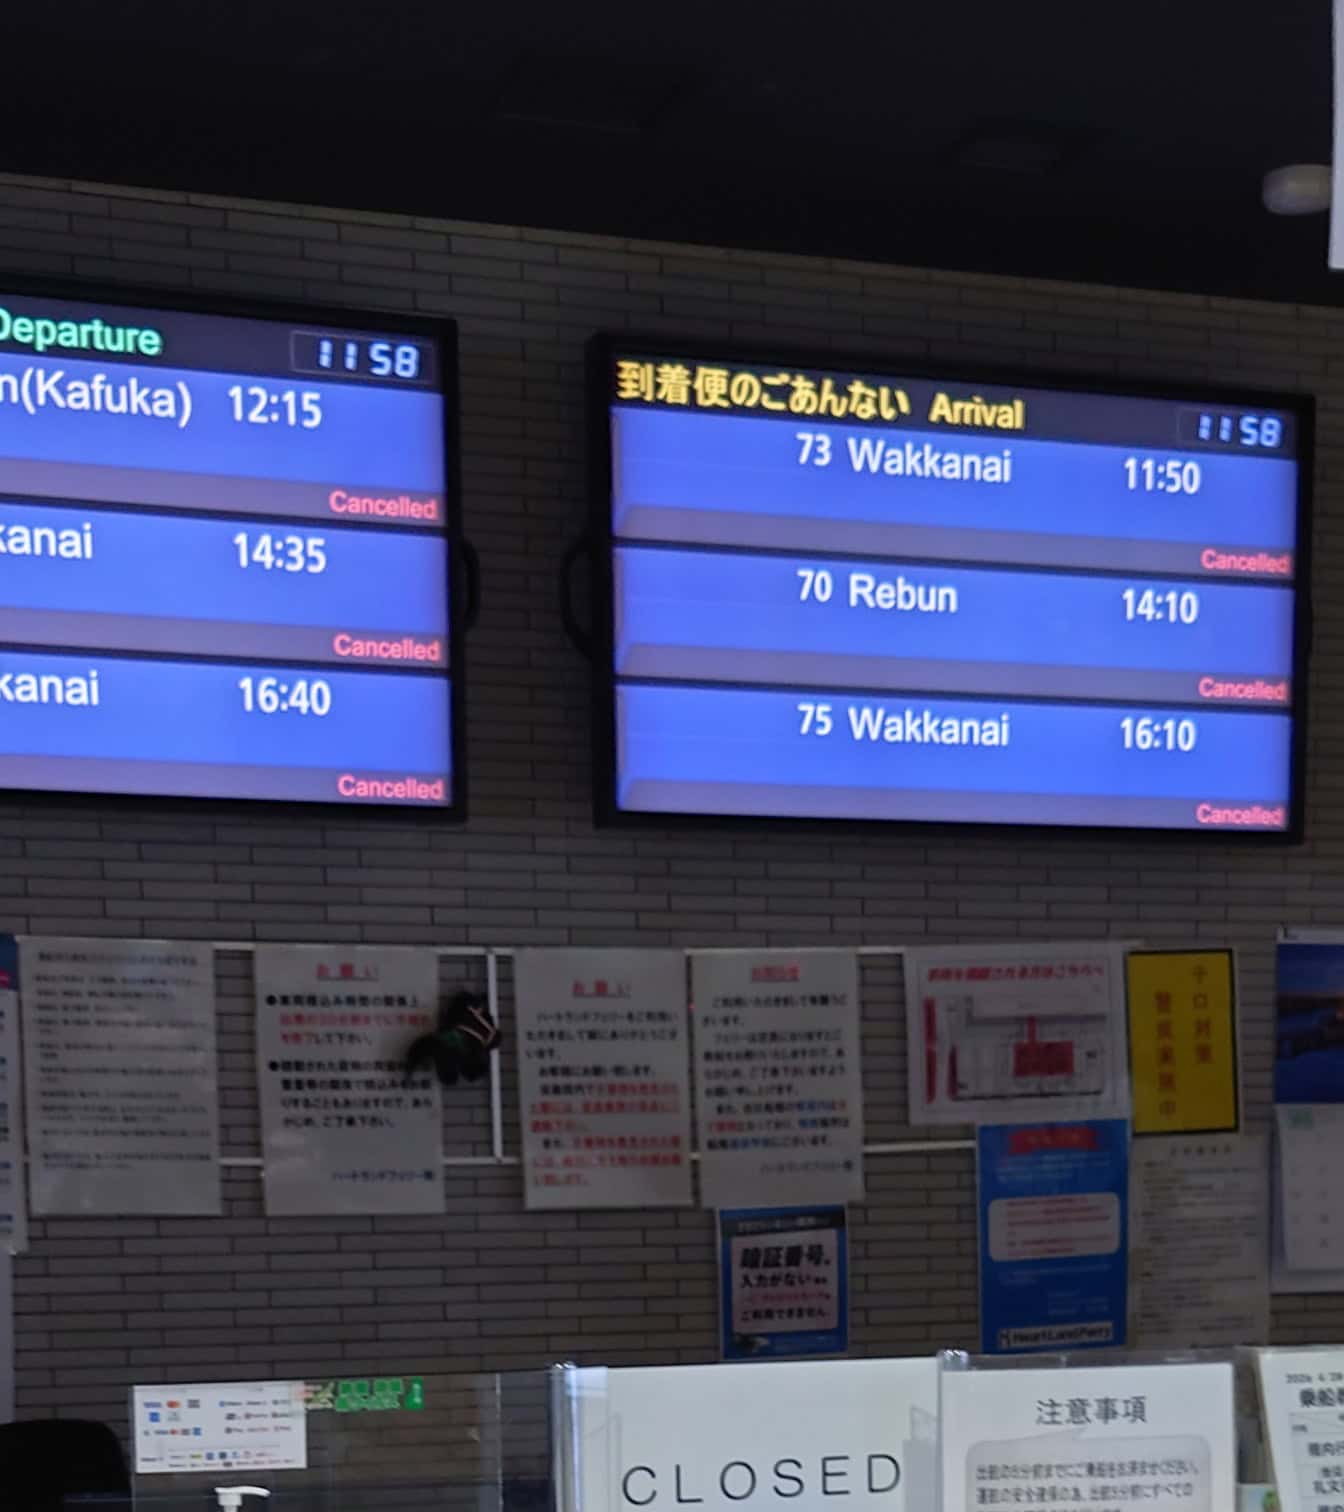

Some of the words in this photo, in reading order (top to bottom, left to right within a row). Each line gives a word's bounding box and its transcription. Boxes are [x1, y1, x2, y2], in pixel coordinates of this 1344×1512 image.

[228, 386, 324, 429] 12:15
[616, 361, 910, 420] 到着便のごあんない
[928, 391, 1025, 430] Arrival
[796, 433, 832, 467] 73
[848, 438, 1013, 485] Wakkanai
[1123, 457, 1201, 495] 11:50
[329, 490, 439, 521] Cancelled
[232, 532, 328, 573] 14:35
[1201, 549, 1290, 574] Cancelled
[797, 570, 832, 602] 70
[849, 574, 957, 613] Rebun
[1121, 588, 1199, 624] 14:10
[333, 634, 442, 662] Cancelled
[238, 676, 332, 716] 16:40
[1198, 677, 1288, 702] Cancelled
[797, 704, 832, 736] 75
[848, 708, 1009, 748] Wakkanai
[1120, 717, 1197, 752] 16:10
[337, 775, 445, 801] Cancelled
[1196, 803, 1286, 828] Cancelled
[1035, 1395, 1148, 1426] 注意事項
[620, 1453, 903, 1506] CLOSED
